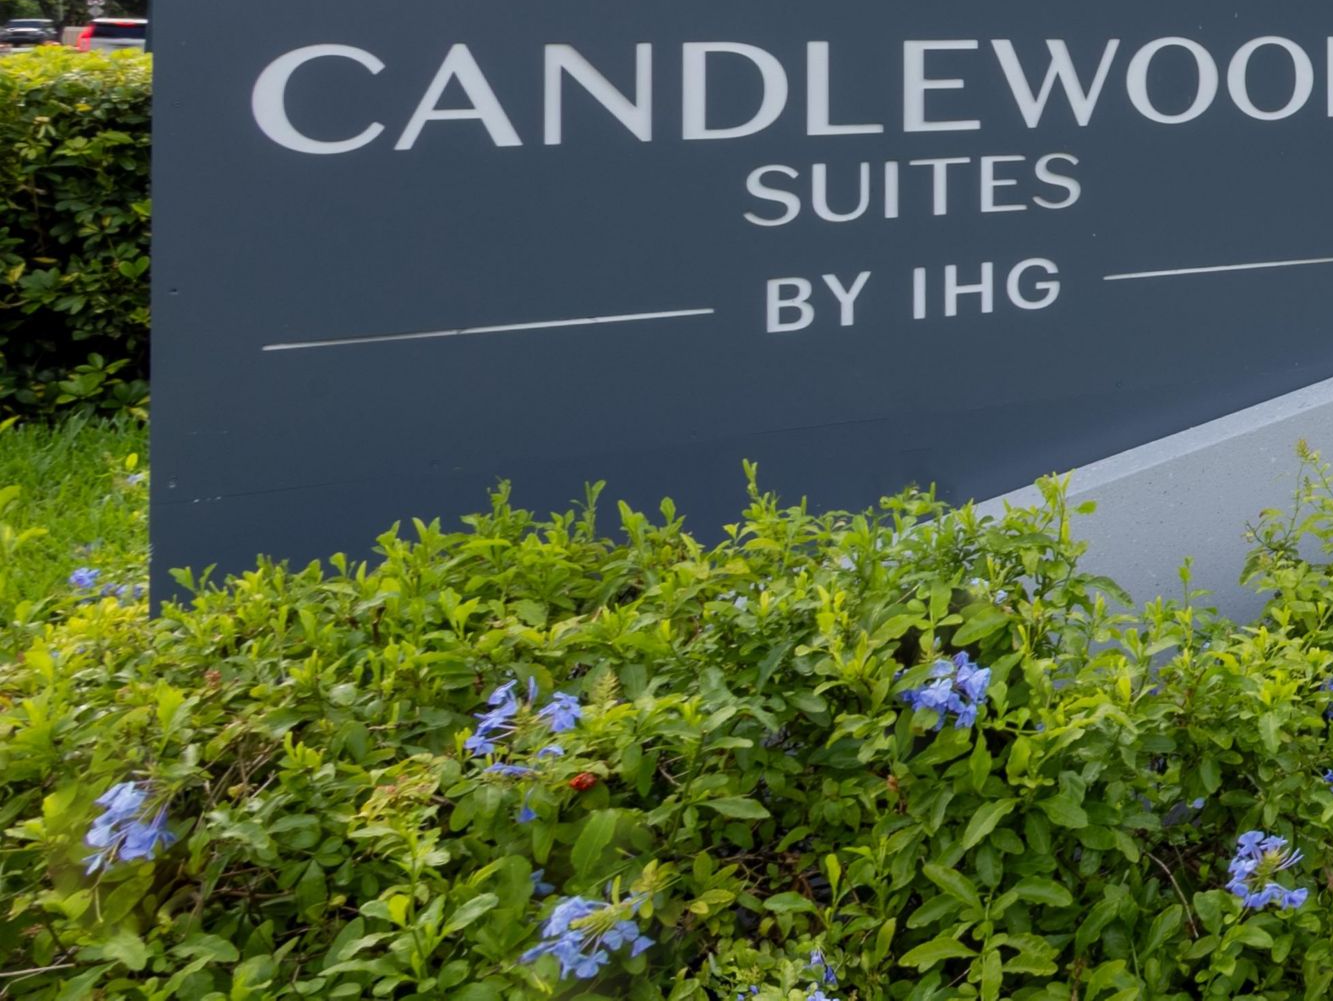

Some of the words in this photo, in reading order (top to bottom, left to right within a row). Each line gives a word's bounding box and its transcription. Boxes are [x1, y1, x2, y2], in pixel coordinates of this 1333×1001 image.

[744, 153, 1082, 227] SUITES
[766, 271, 871, 333] BY
[913, 257, 1061, 320] IHG
